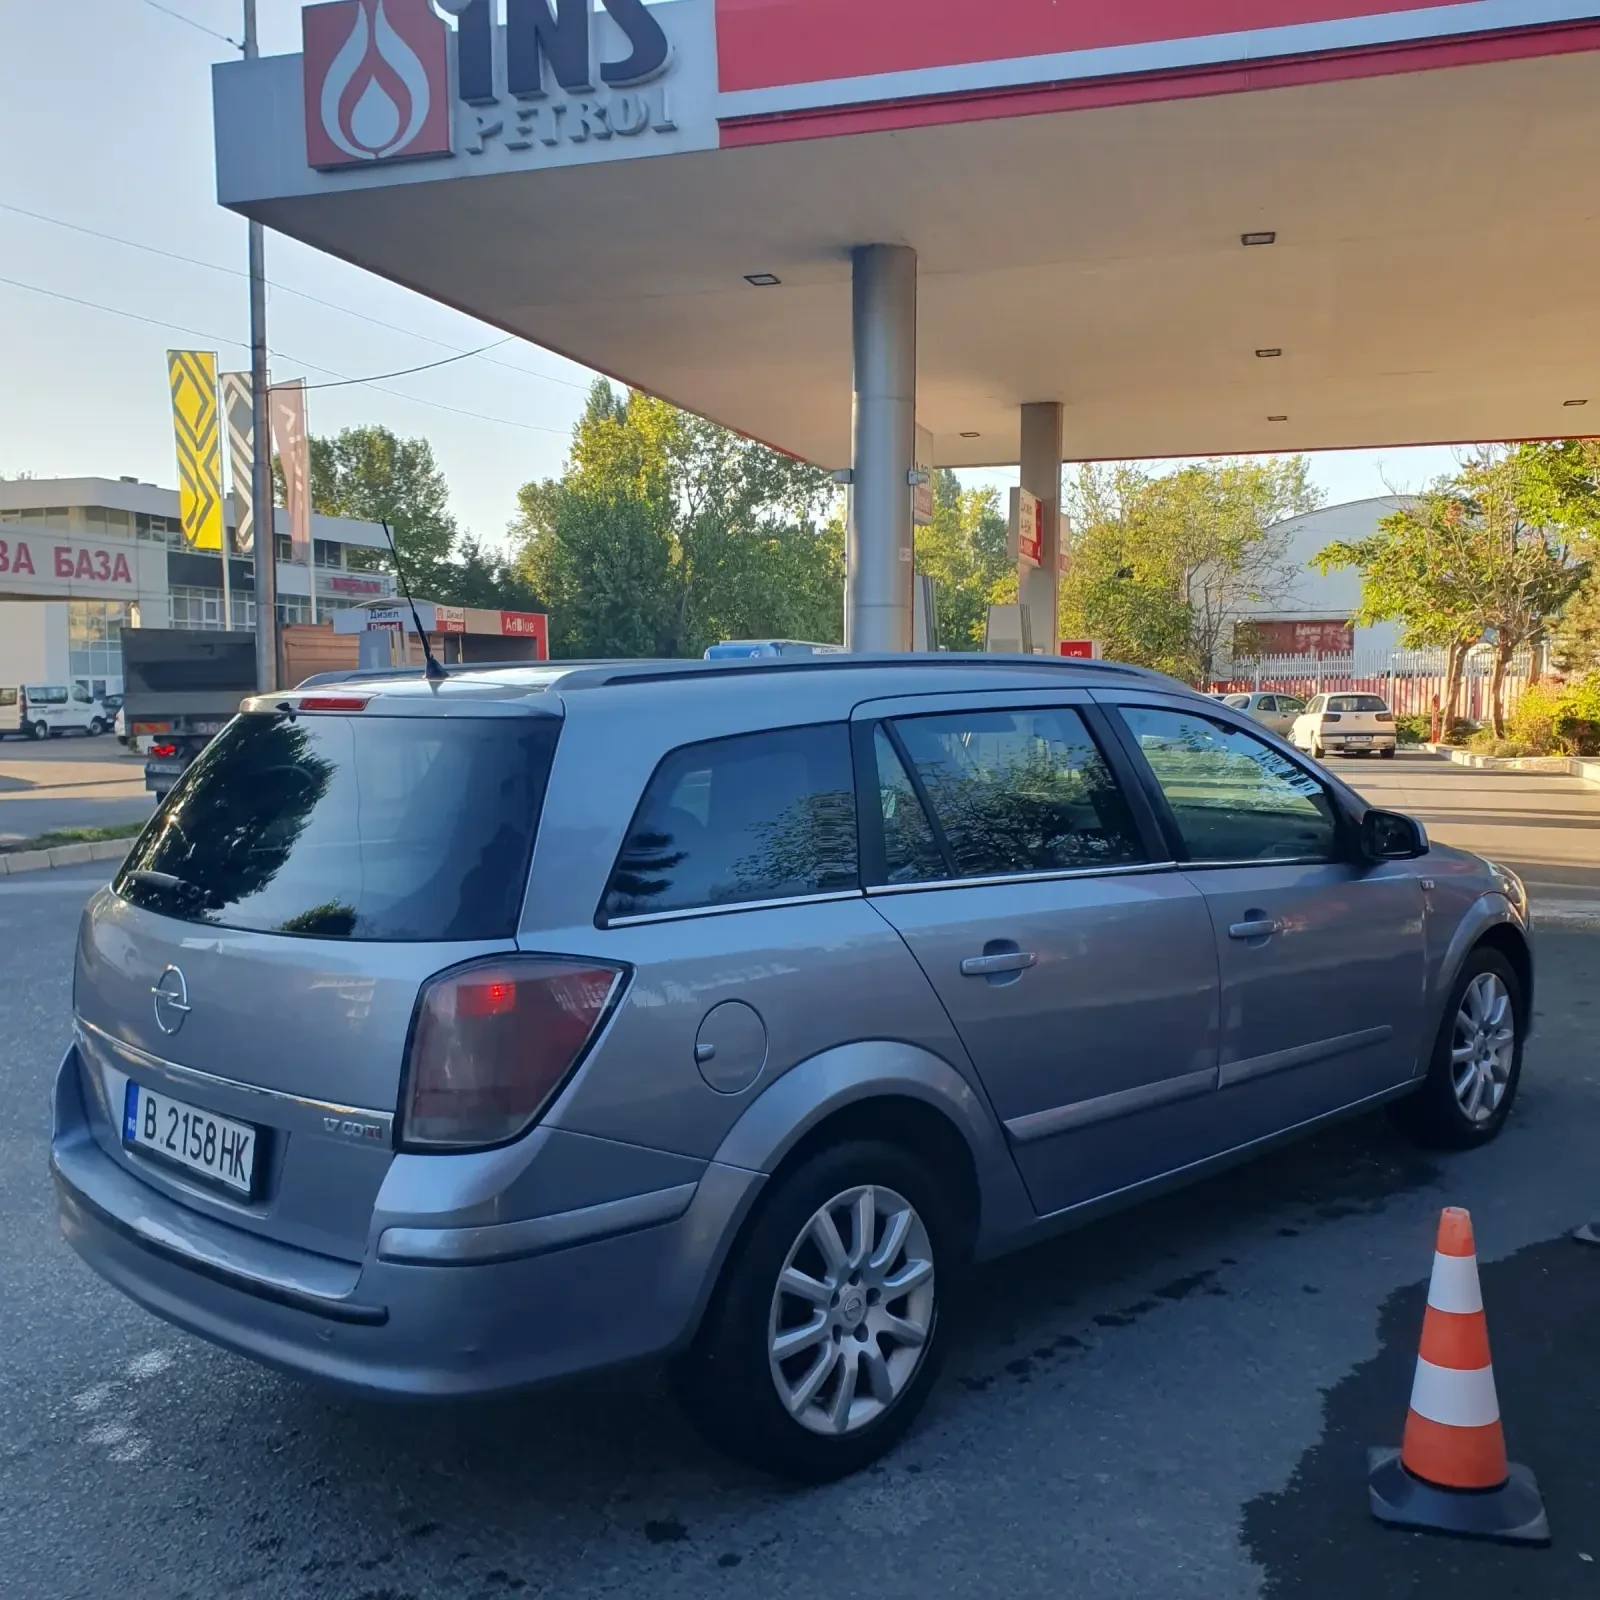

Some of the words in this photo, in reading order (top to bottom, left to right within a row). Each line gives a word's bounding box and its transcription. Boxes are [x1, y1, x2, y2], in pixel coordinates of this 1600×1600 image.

[462, 88, 678, 155] PETROL
[54, 546, 132, 583] БАЗА
[370, 611, 399, 620] Дизел
[446, 622, 464, 633] Diesel
[505, 617, 535, 633] AdBlue
